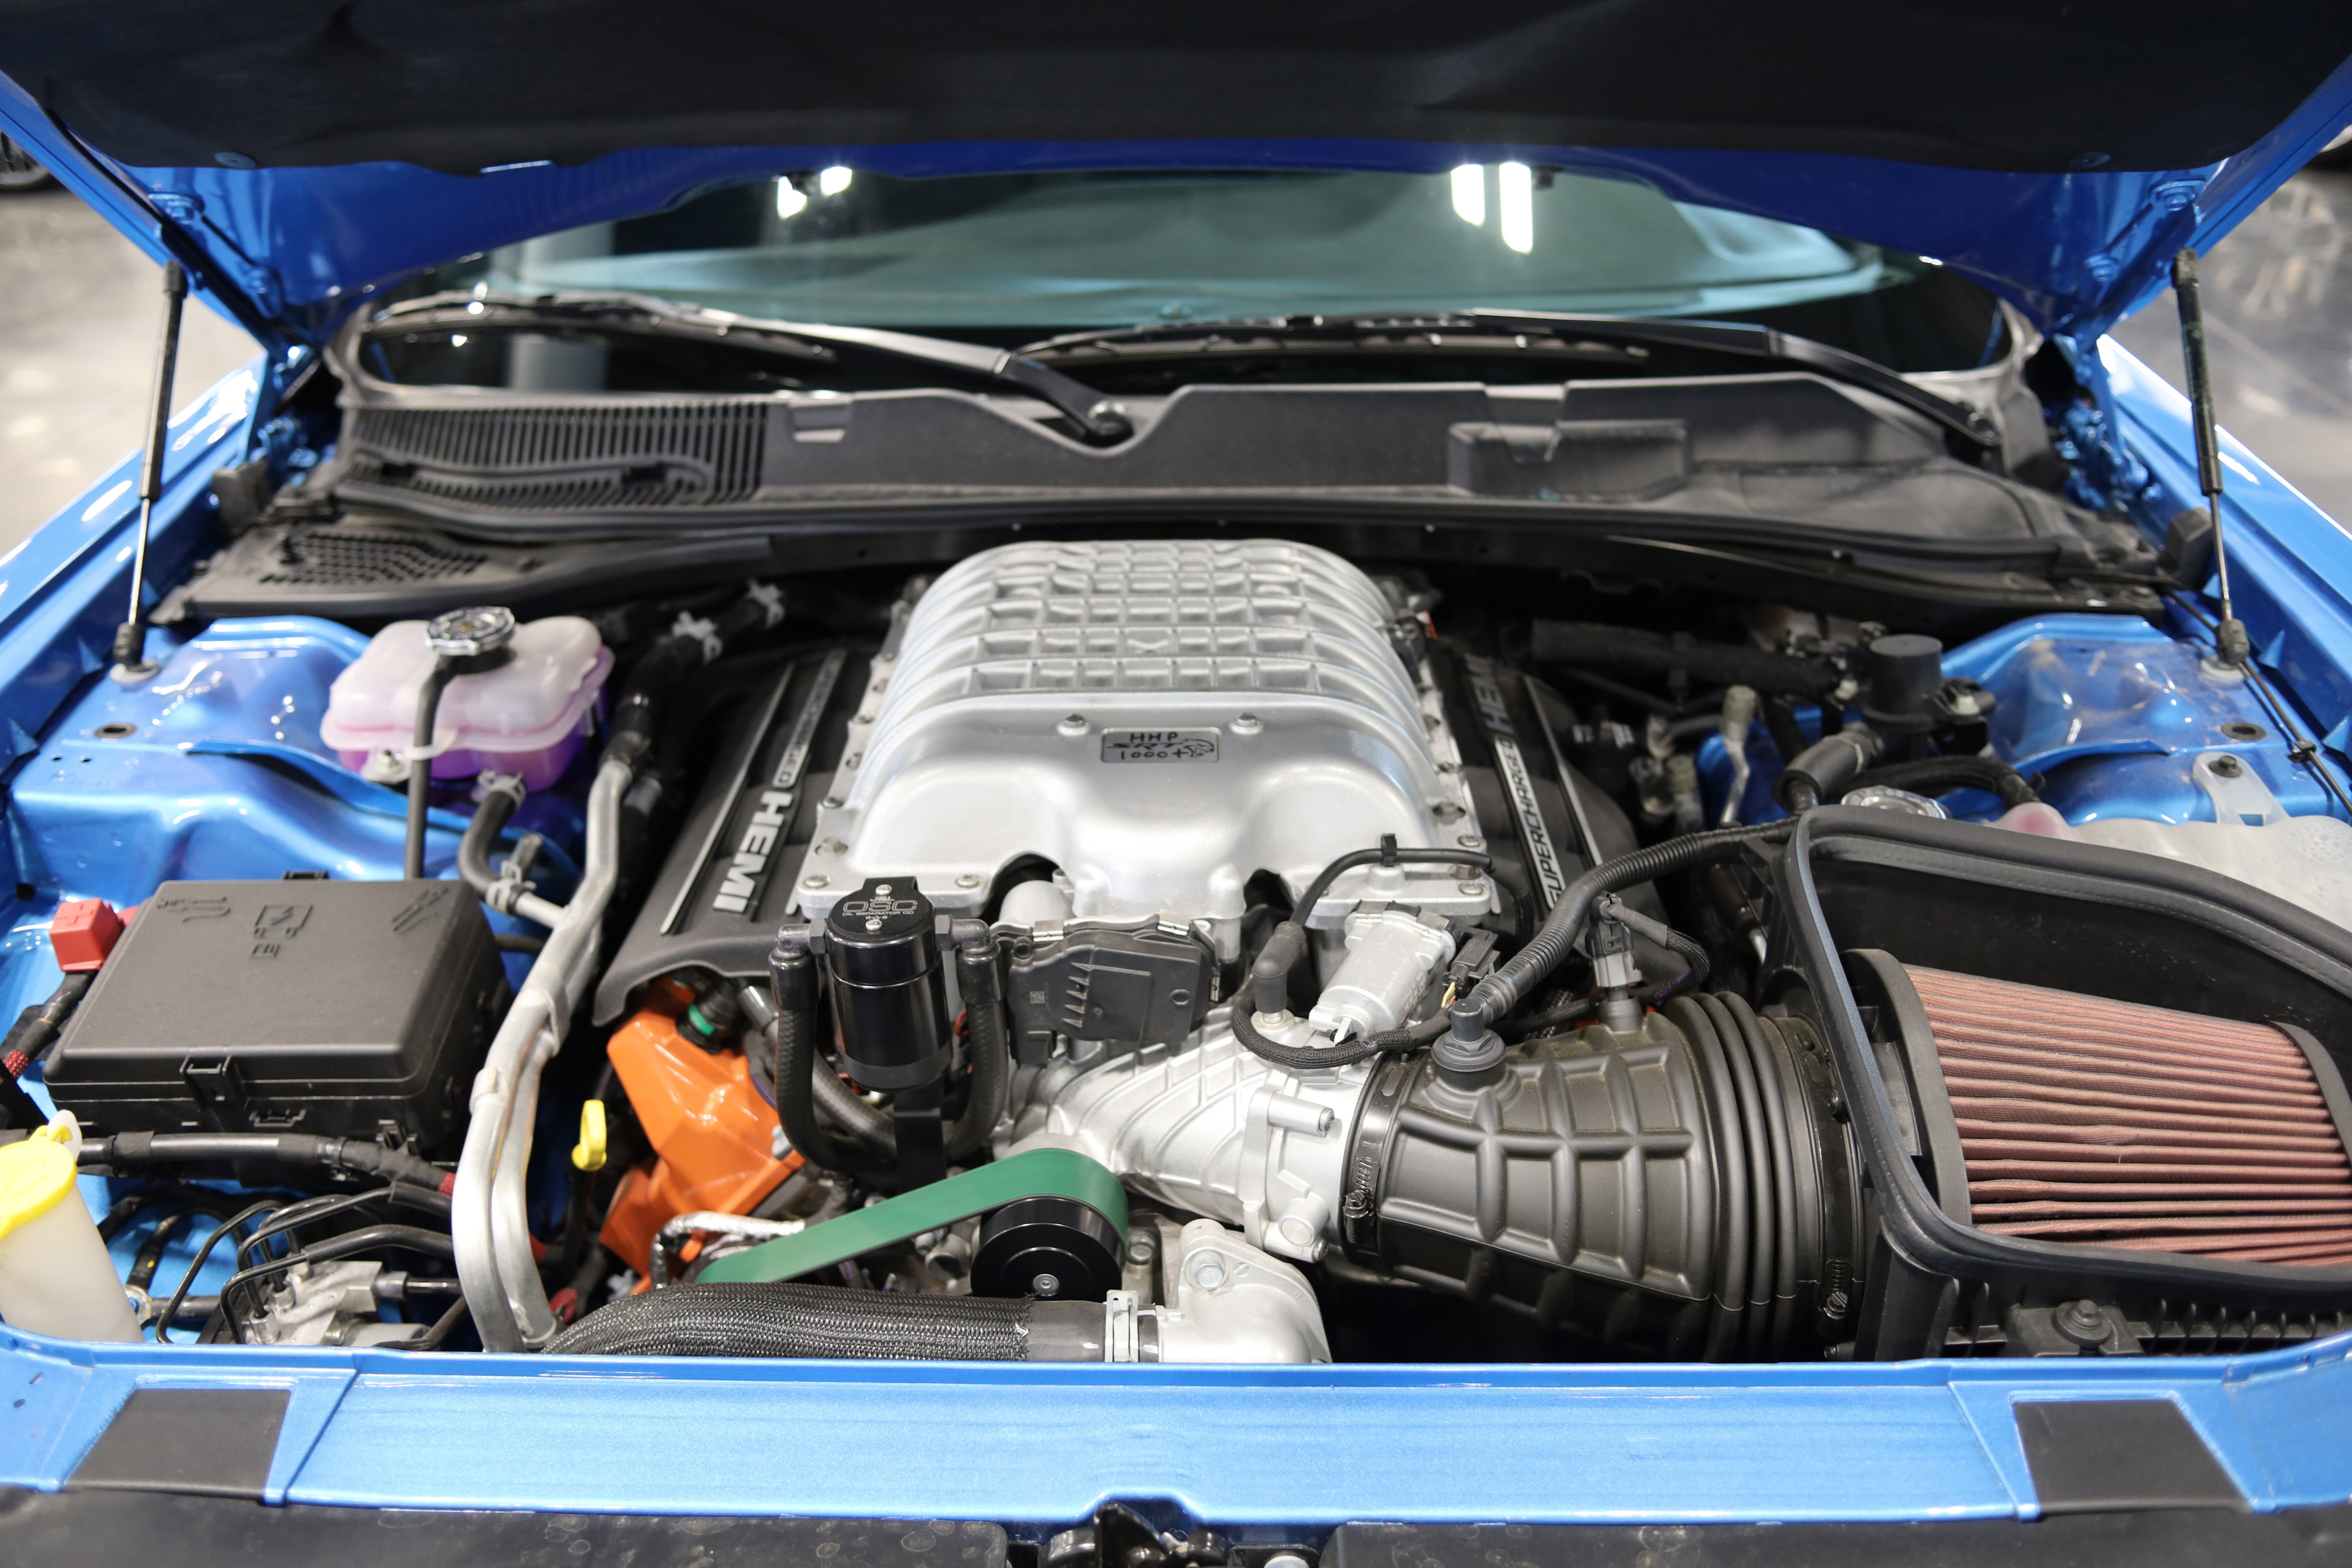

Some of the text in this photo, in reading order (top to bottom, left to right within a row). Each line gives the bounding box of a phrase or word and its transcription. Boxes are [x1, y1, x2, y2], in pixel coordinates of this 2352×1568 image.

[1131, 732, 1178, 742] HHP
[713, 791, 793, 913] HEMI
[843, 900, 917, 912] OSC
